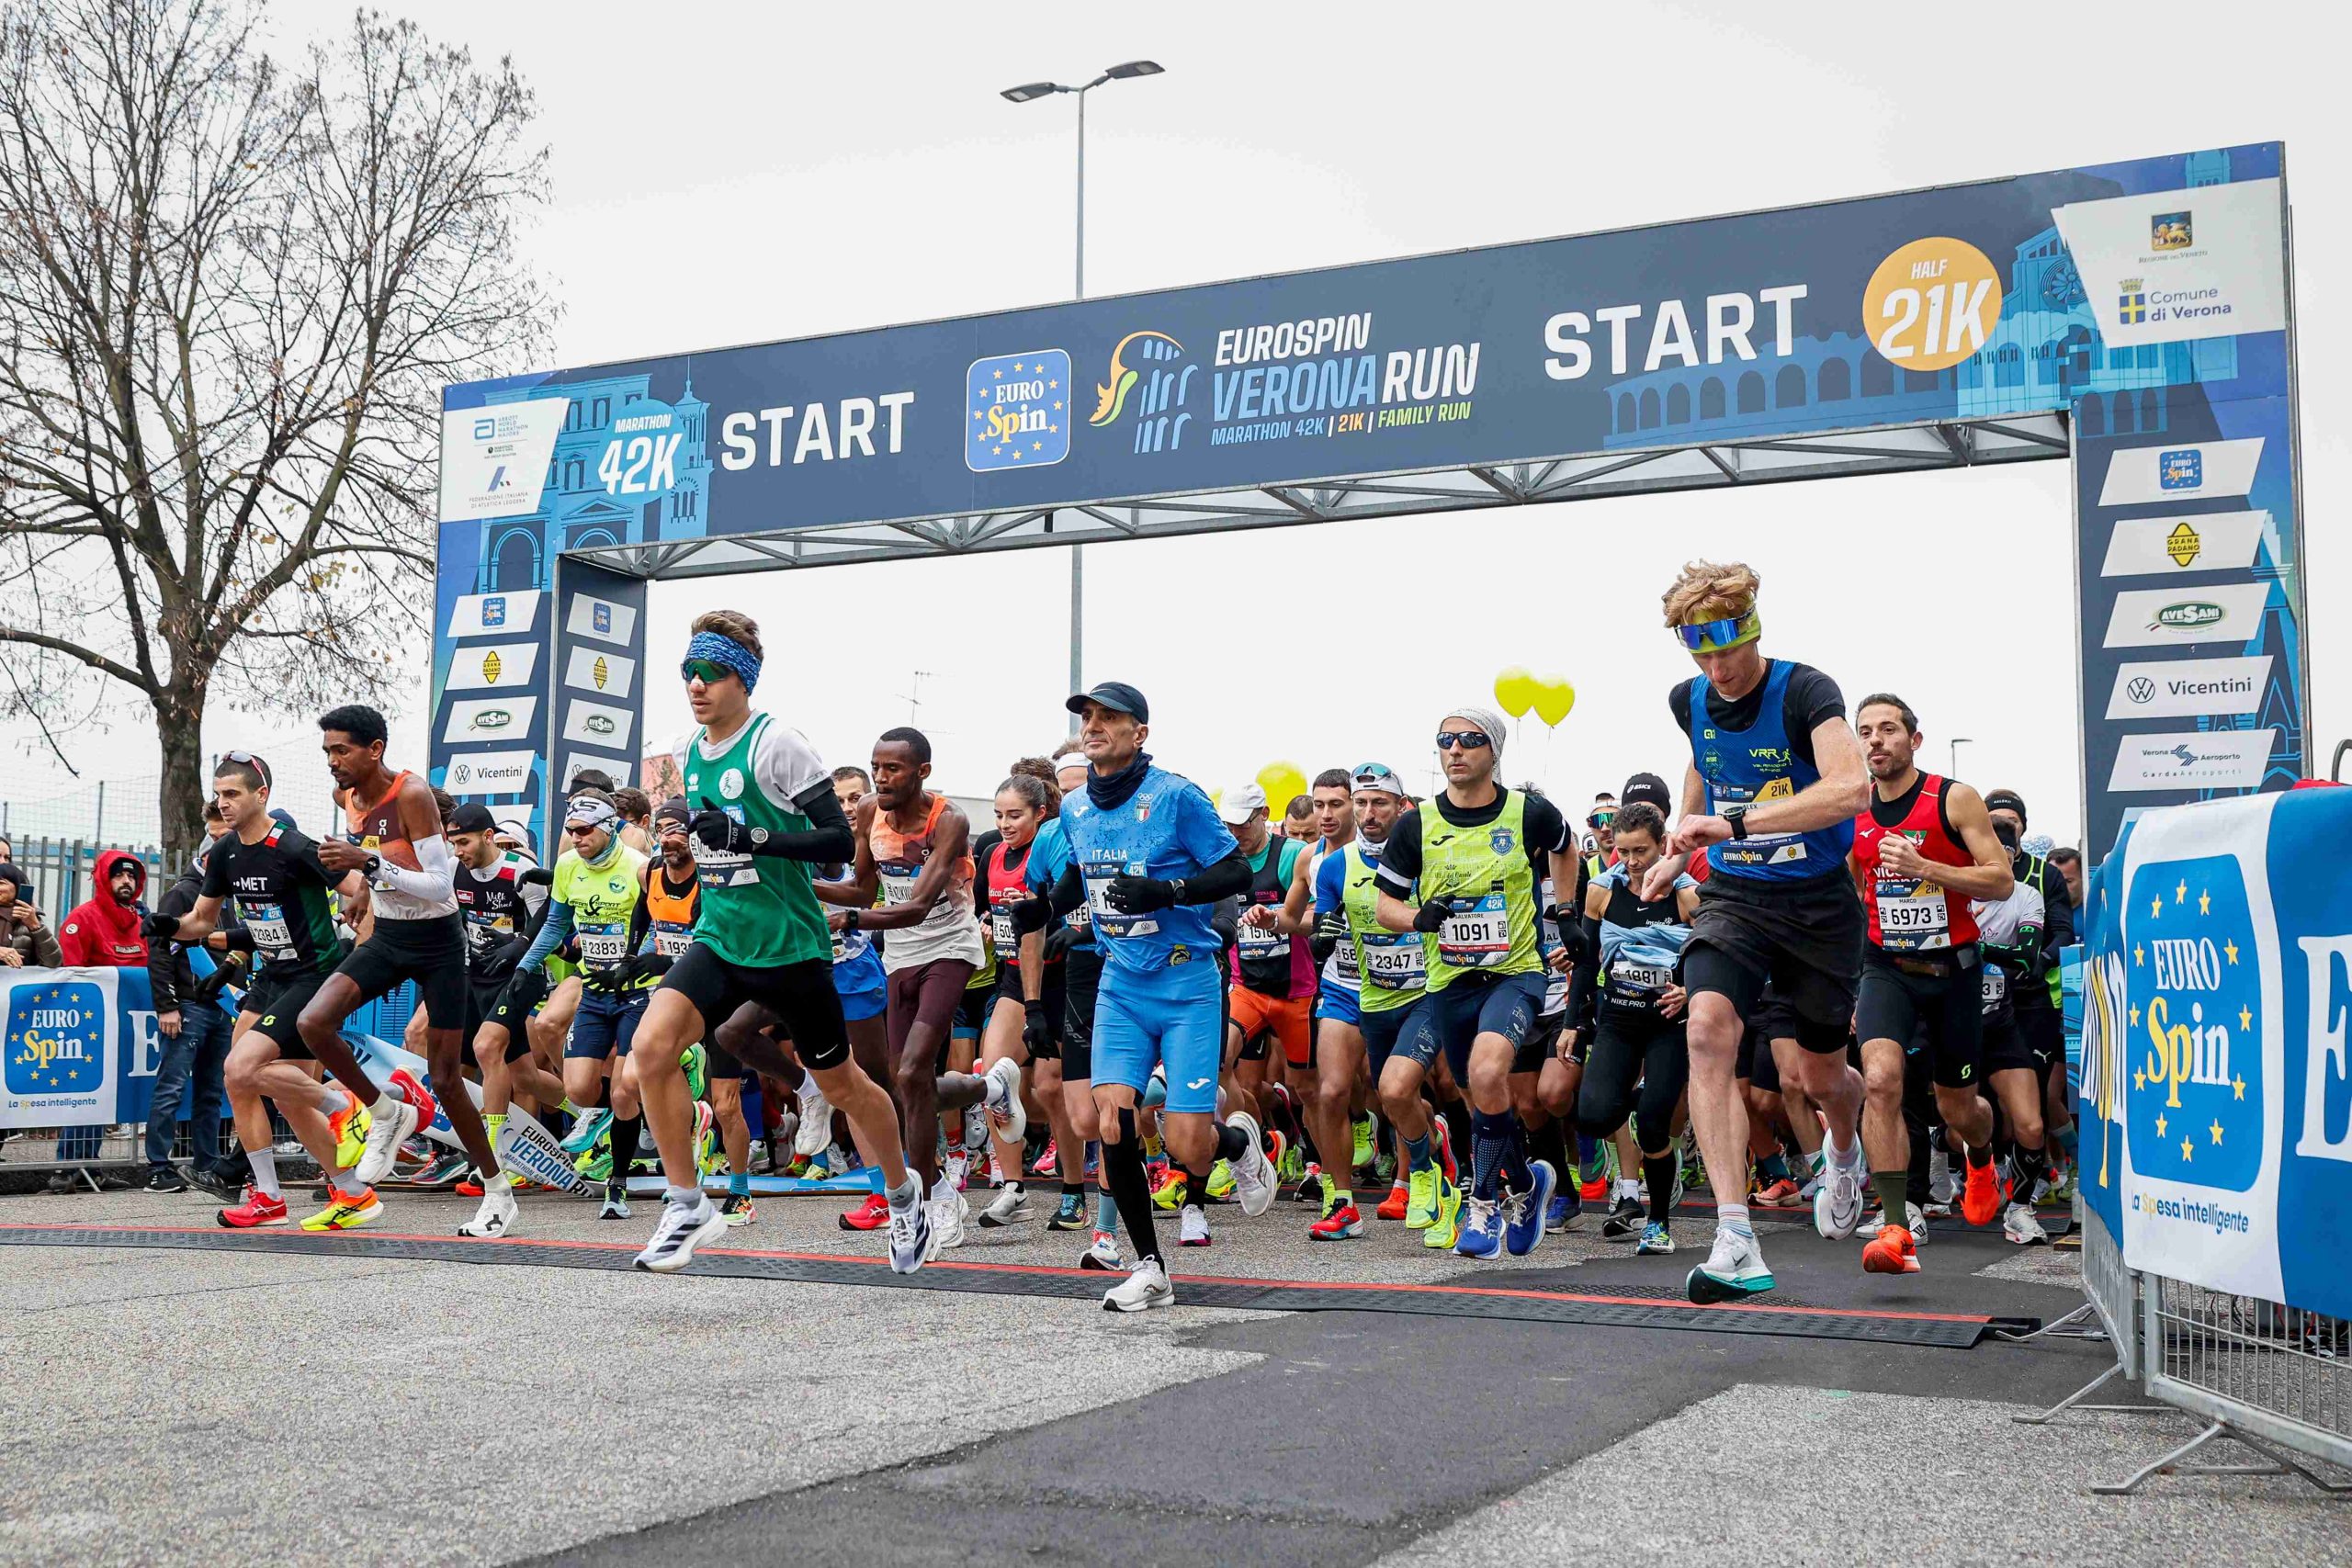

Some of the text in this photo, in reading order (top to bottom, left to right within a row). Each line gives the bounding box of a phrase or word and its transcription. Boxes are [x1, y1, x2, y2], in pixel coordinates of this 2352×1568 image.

[1911, 258, 1948, 279] HALF
[2151, 288, 2218, 304] Comune
[1878, 278, 1994, 359] 21K
[2151, 304, 2232, 321] di Verona
[1215, 312, 1372, 367] EUROSPIN
[1544, 284, 1808, 380] START
[1381, 343, 1480, 403] RUN
[994, 379, 1045, 403] EURO
[615, 413, 672, 434] MARATHON
[720, 391, 915, 471] START
[987, 405, 1047, 443] Spin
[1211, 401, 1472, 446] MARATHON 42K 21K FAMILY RUN
[598, 433, 683, 495] 42K
[2167, 467, 2194, 480] Spin
[469, 493, 503, 502] FEDERAZIONE
[2162, 605, 2220, 623] AVESANI
[2168, 677, 2251, 695] Vicentini
[1749, 749, 1780, 760] VRR
[478, 765, 522, 778] Vicentini
[1771, 784, 1789, 796] 21K
[1092, 849, 1127, 861] ITALIA
[1129, 864, 1145, 876] 42K
[240, 877, 267, 891] MET
[486, 891, 505, 904] Milk
[1487, 899, 1503, 909] 42K
[1891, 908, 1931, 925] 6973
[1406, 934, 1419, 943] 42K
[1453, 923, 1489, 942] 1091
[589, 942, 617, 954] 2383
[1375, 954, 1410, 969] 2347
[2152, 936, 2221, 991] EURO
[1625, 970, 1657, 985] 1881
[1611, 998, 1627, 1006] NIKE
[31, 1010, 80, 1029] EURO
[23, 1030, 84, 1069] Spin
[2146, 996, 2231, 1109] Spin
[8, 1098, 96, 1109] La Spesa intelligente
[504, 1153, 533, 1176] MARATHON
[510, 1135, 574, 1190] VERONA
[2143, 1192, 2180, 1220] Spesa
[2183, 1197, 2249, 1235] intelligente
